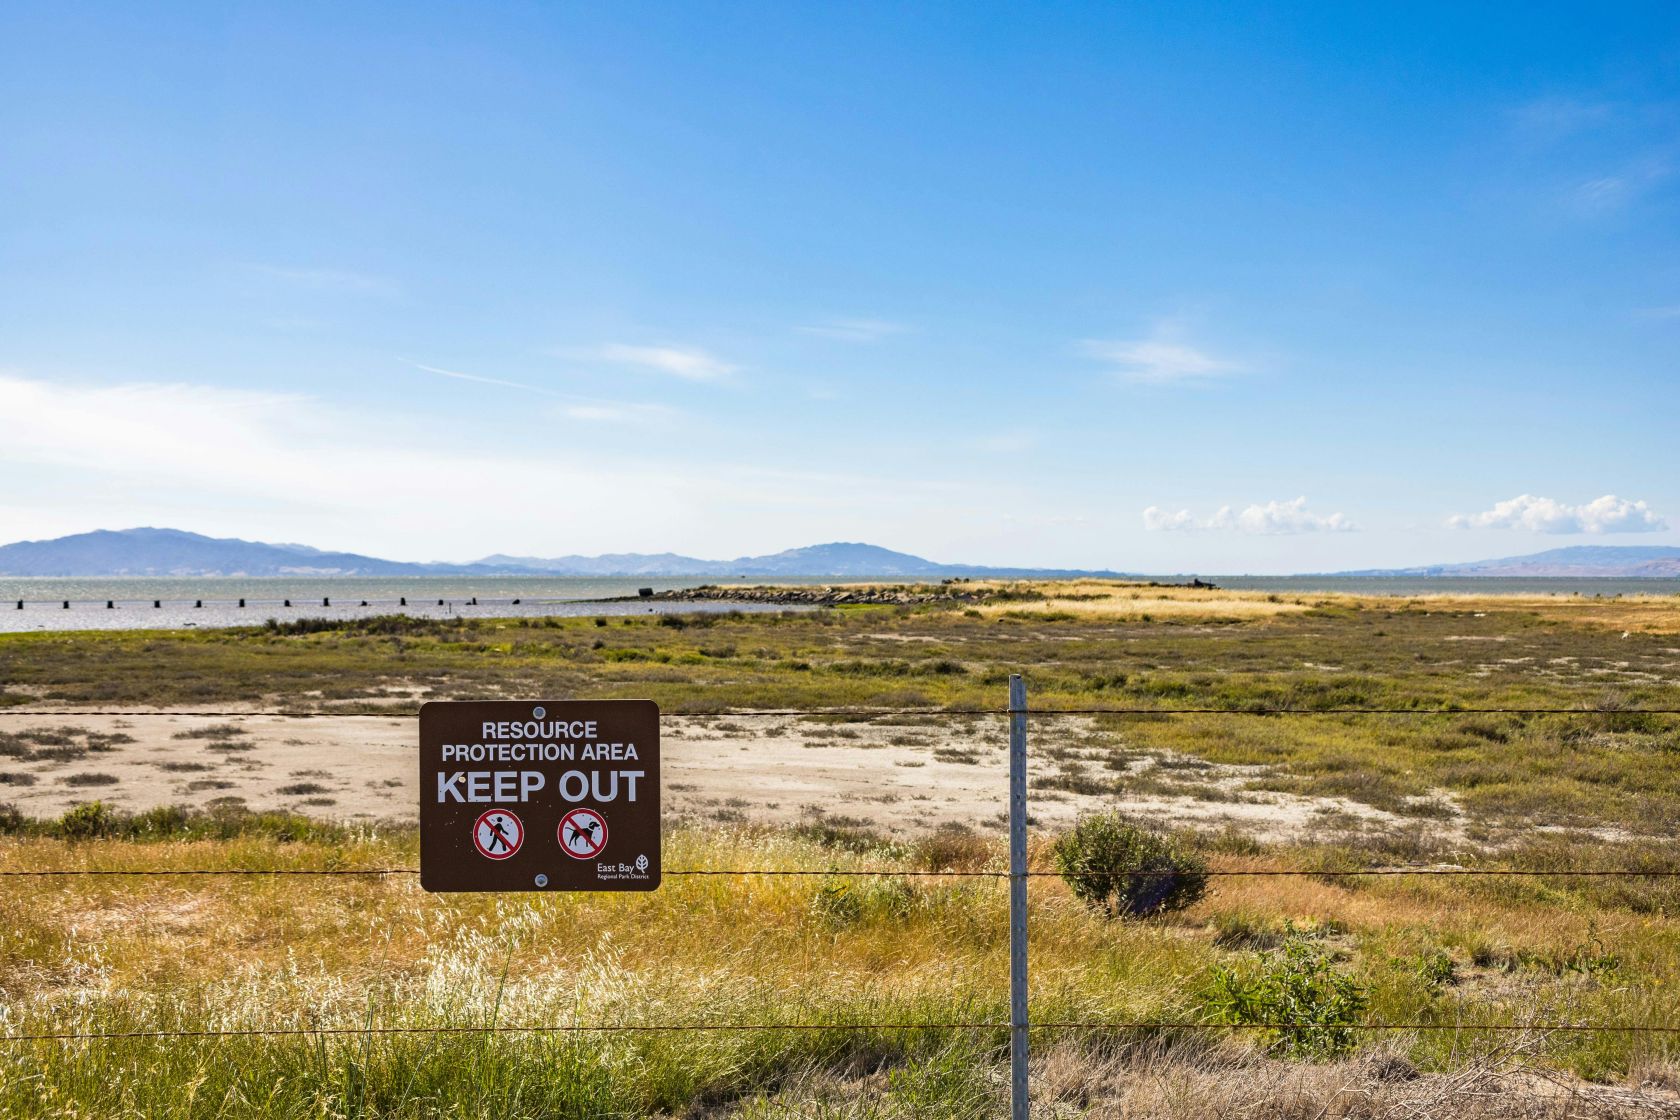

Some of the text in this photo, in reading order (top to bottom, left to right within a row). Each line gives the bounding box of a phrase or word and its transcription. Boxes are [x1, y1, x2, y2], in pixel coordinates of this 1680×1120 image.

[482, 721, 597, 738] RESOURCE
[442, 743, 638, 761] PROTECTION AREA
[437, 770, 644, 802] KEEP OUT
[597, 863, 634, 875] East Bay
